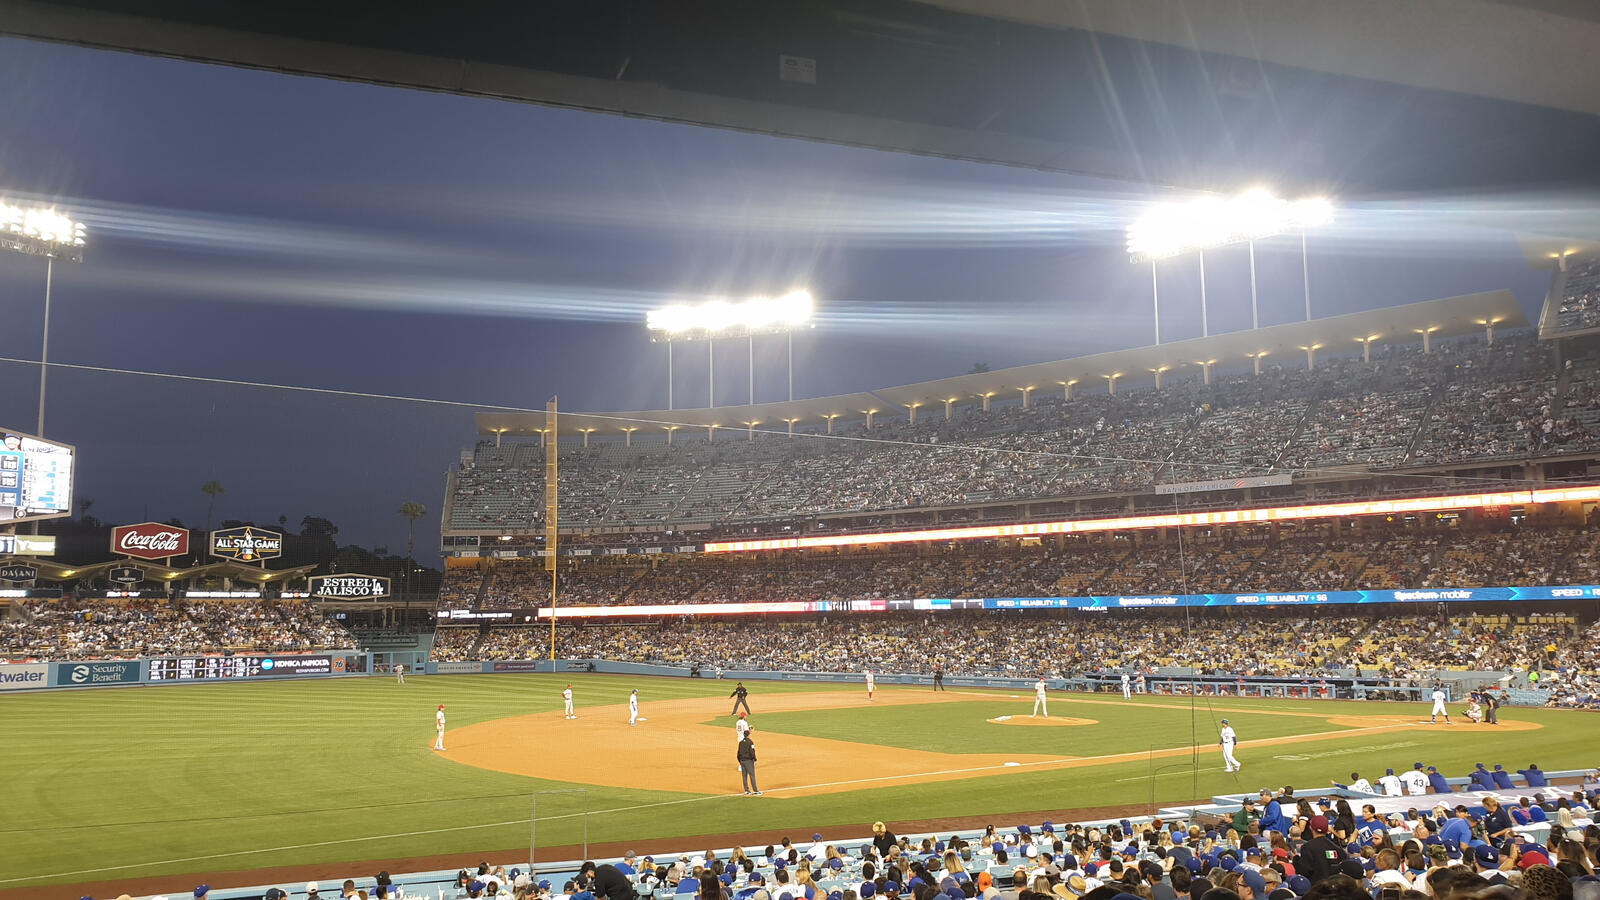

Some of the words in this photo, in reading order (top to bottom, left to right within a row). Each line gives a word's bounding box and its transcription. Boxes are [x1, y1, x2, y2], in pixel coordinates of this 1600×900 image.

[121, 530, 182, 551] Coca-Cola
[216, 539, 231, 548] ALL
[234, 539, 253, 548] STAR
[255, 540, 279, 549] GAME
[1, 569, 35, 577] DASANI
[323, 578, 372, 587] ESTREL
[372, 578, 384, 595] LA
[316, 586, 370, 596] JALISCO
[1439, 589, 1470, 599] mobile
[1551, 588, 1583, 598] SPEED
[274, 660, 300, 668] KONICA
[301, 659, 330, 667] MINOLTA
[335, 660, 344, 668] 76
[92, 664, 127, 673] Security
[92, 673, 122, 682] Benefit
[1413, 779, 1424, 788] 43
